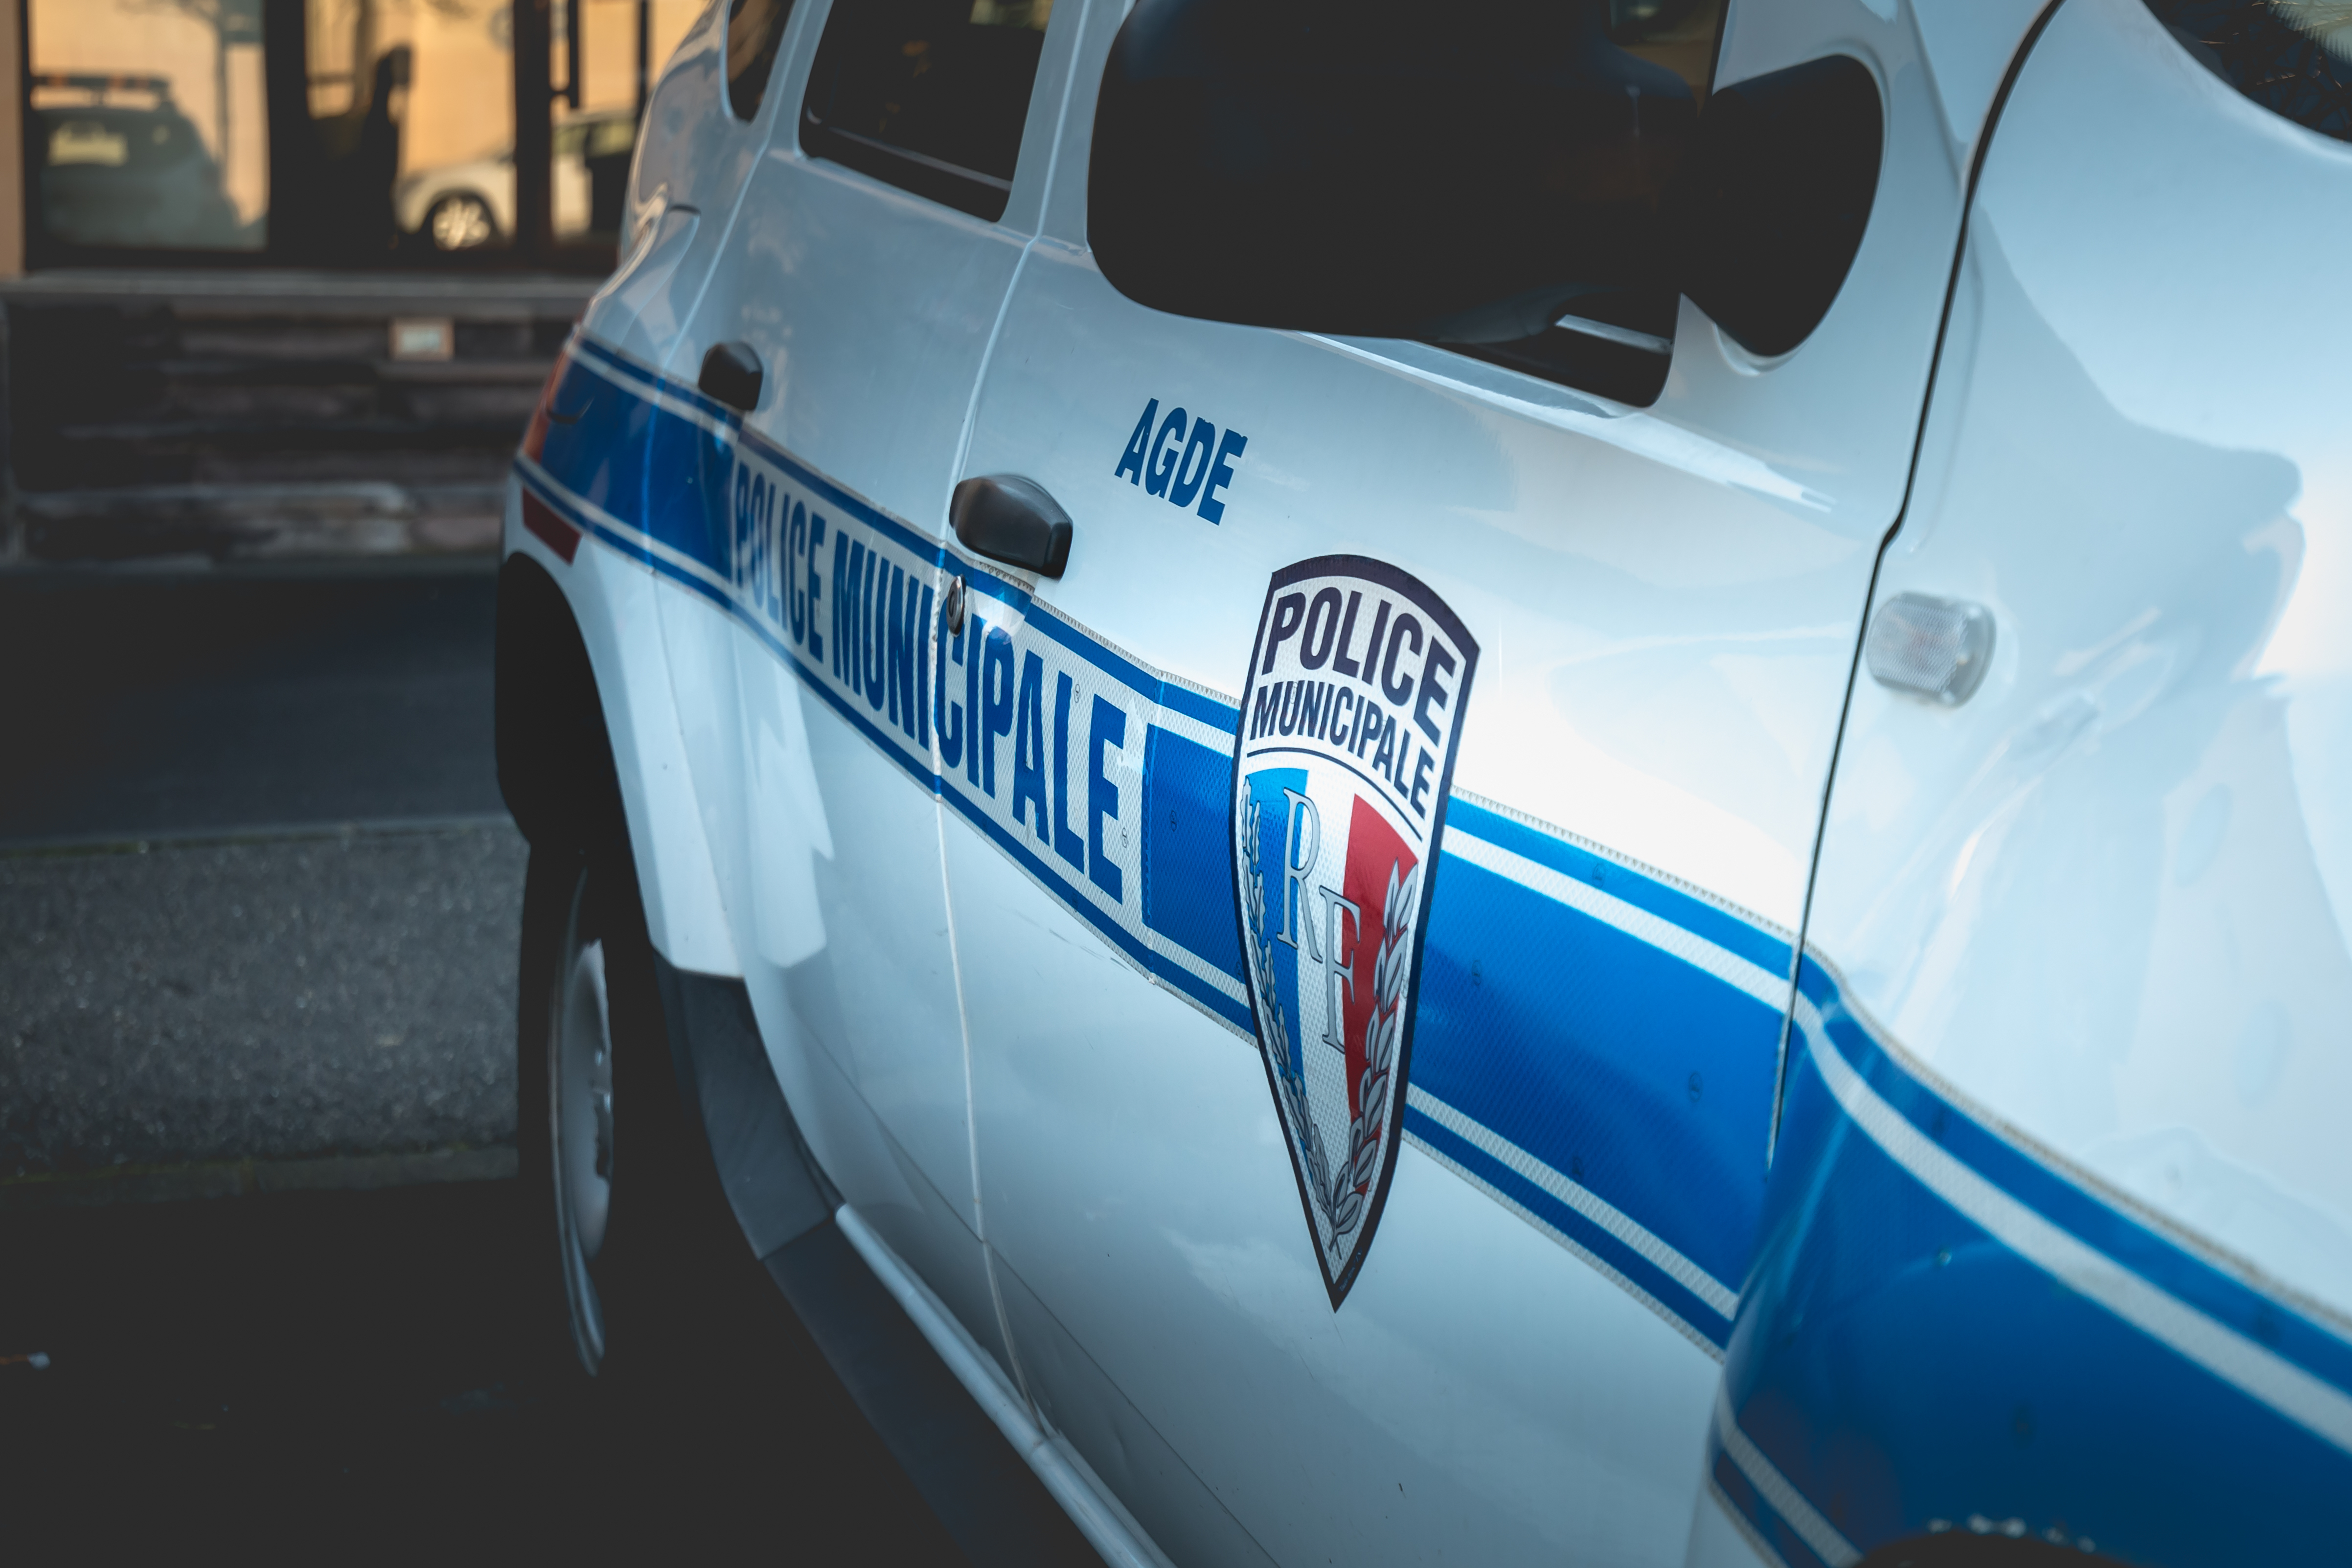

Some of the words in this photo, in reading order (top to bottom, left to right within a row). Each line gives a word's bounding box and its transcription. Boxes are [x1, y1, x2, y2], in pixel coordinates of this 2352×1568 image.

[1115, 398, 1248, 525] AGDE
[736, 461, 826, 664] POLICE
[833, 530, 1126, 905] MUNICIPALE
[1261, 587, 1456, 748] POLICE
[1250, 681, 1435, 819] MUNICIPALE
